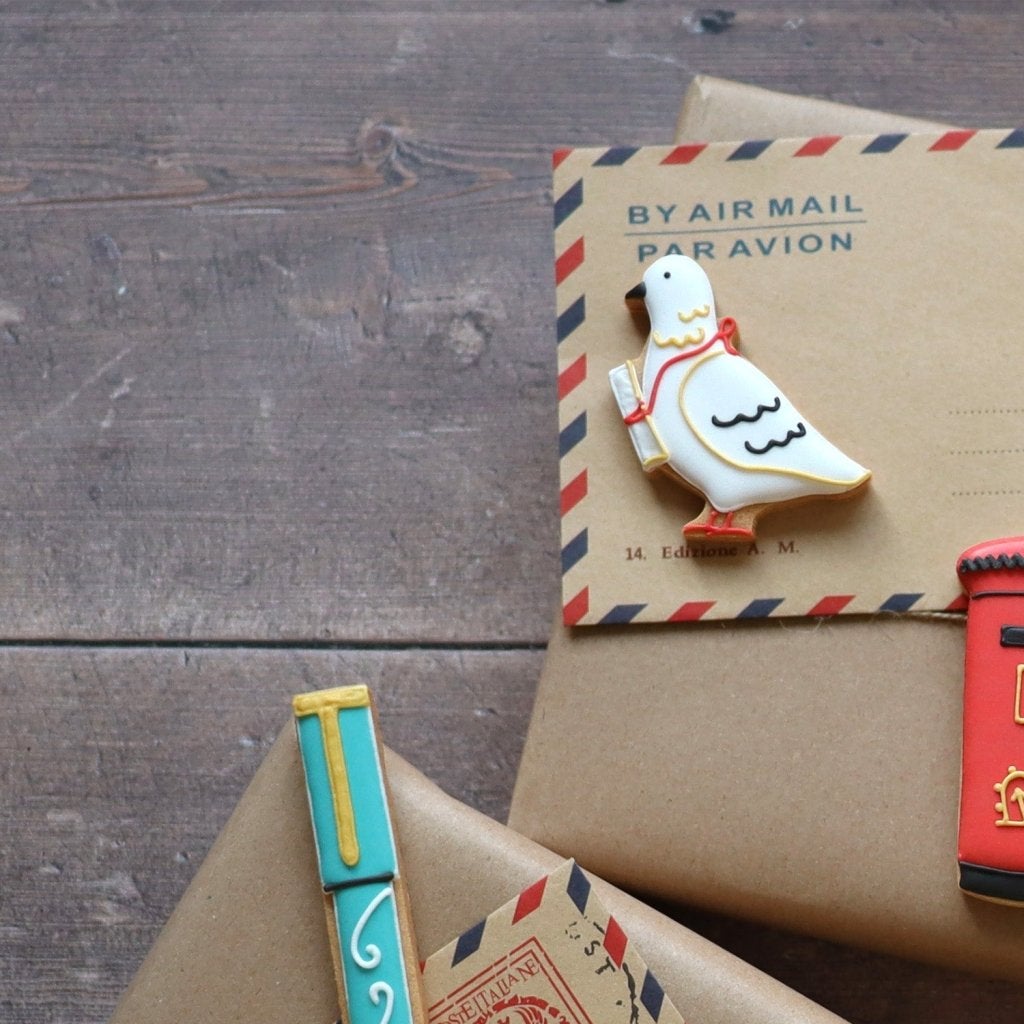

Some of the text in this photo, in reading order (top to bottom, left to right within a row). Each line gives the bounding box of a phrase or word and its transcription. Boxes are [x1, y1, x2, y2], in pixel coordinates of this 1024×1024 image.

[628, 195, 863, 225] BY AIR MAIL
[728, 233, 853, 259] AVION
[625, 546, 647, 561] 14.
[777, 540, 800, 554] M.
